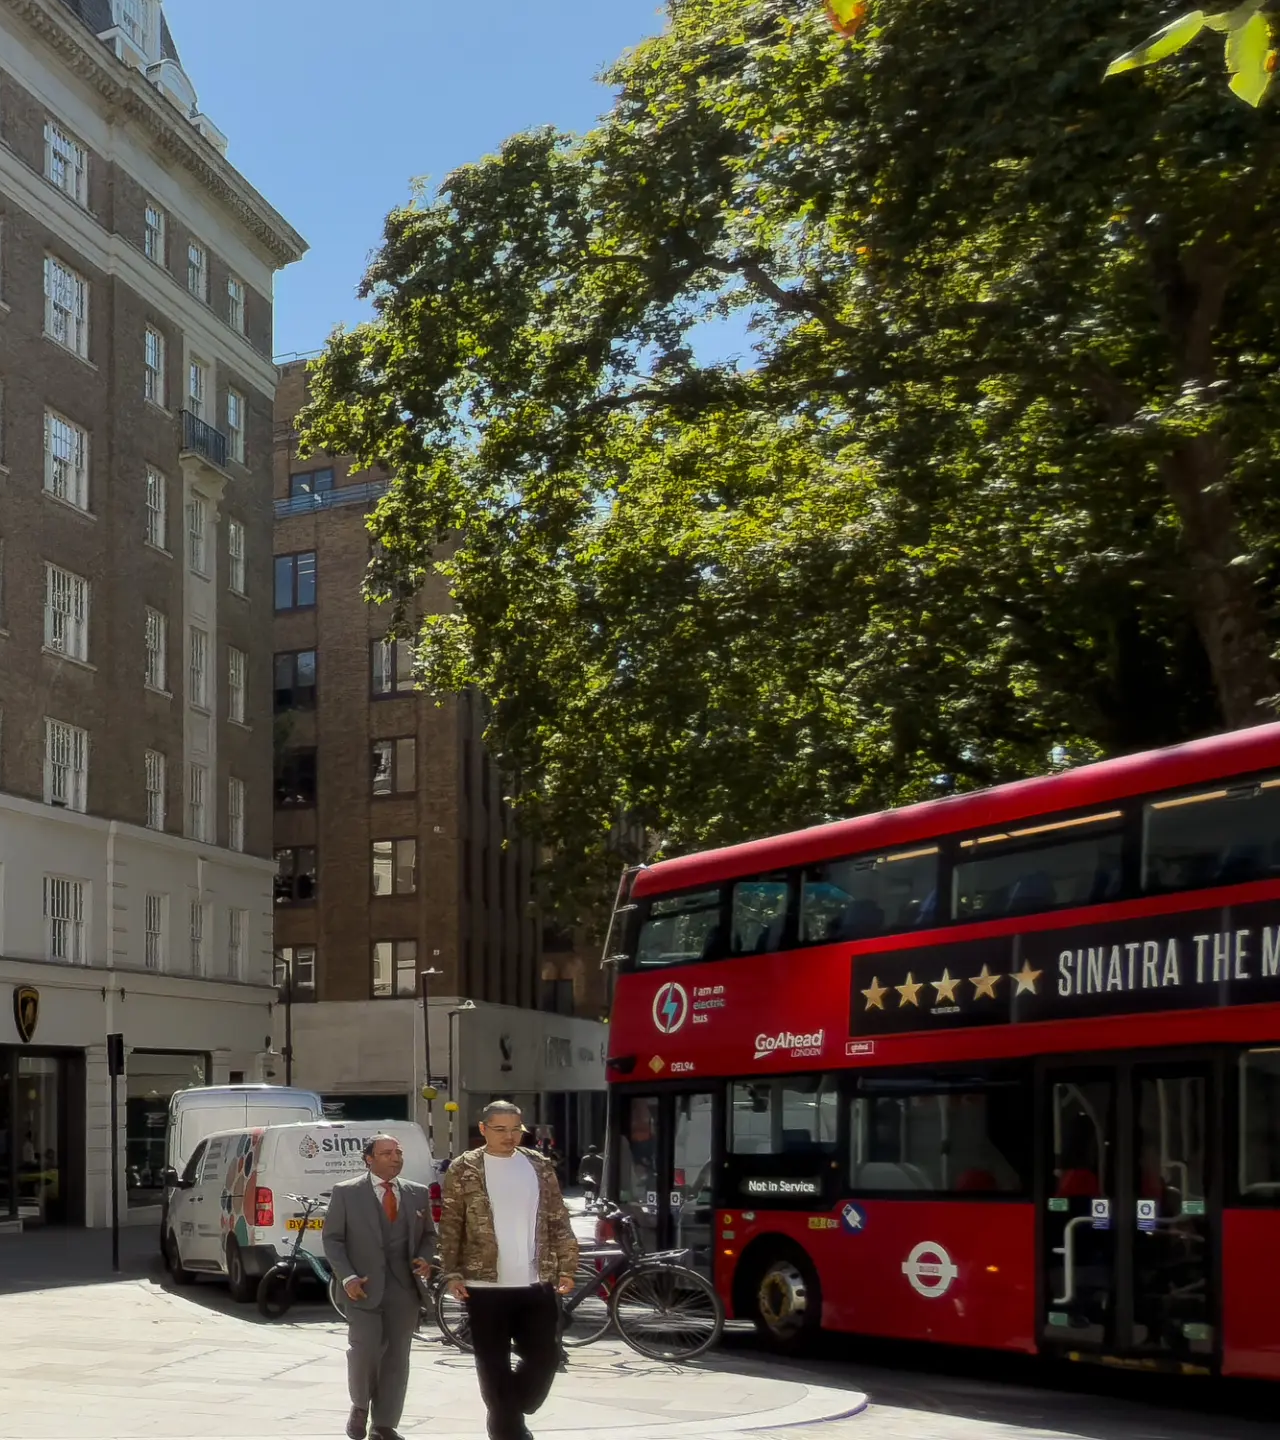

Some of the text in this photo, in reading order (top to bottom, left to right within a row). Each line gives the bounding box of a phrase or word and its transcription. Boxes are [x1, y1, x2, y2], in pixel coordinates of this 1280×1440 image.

[1058, 938, 1180, 997] SINATRA
[1192, 929, 1251, 984] THE
[698, 987, 712, 996] am
[713, 985, 724, 995] an
[693, 998, 726, 1010] electric
[692, 1013, 708, 1024] bus
[790, 1047, 822, 1058] LONDON
[748, 1180, 815, 1193] Not in Service
